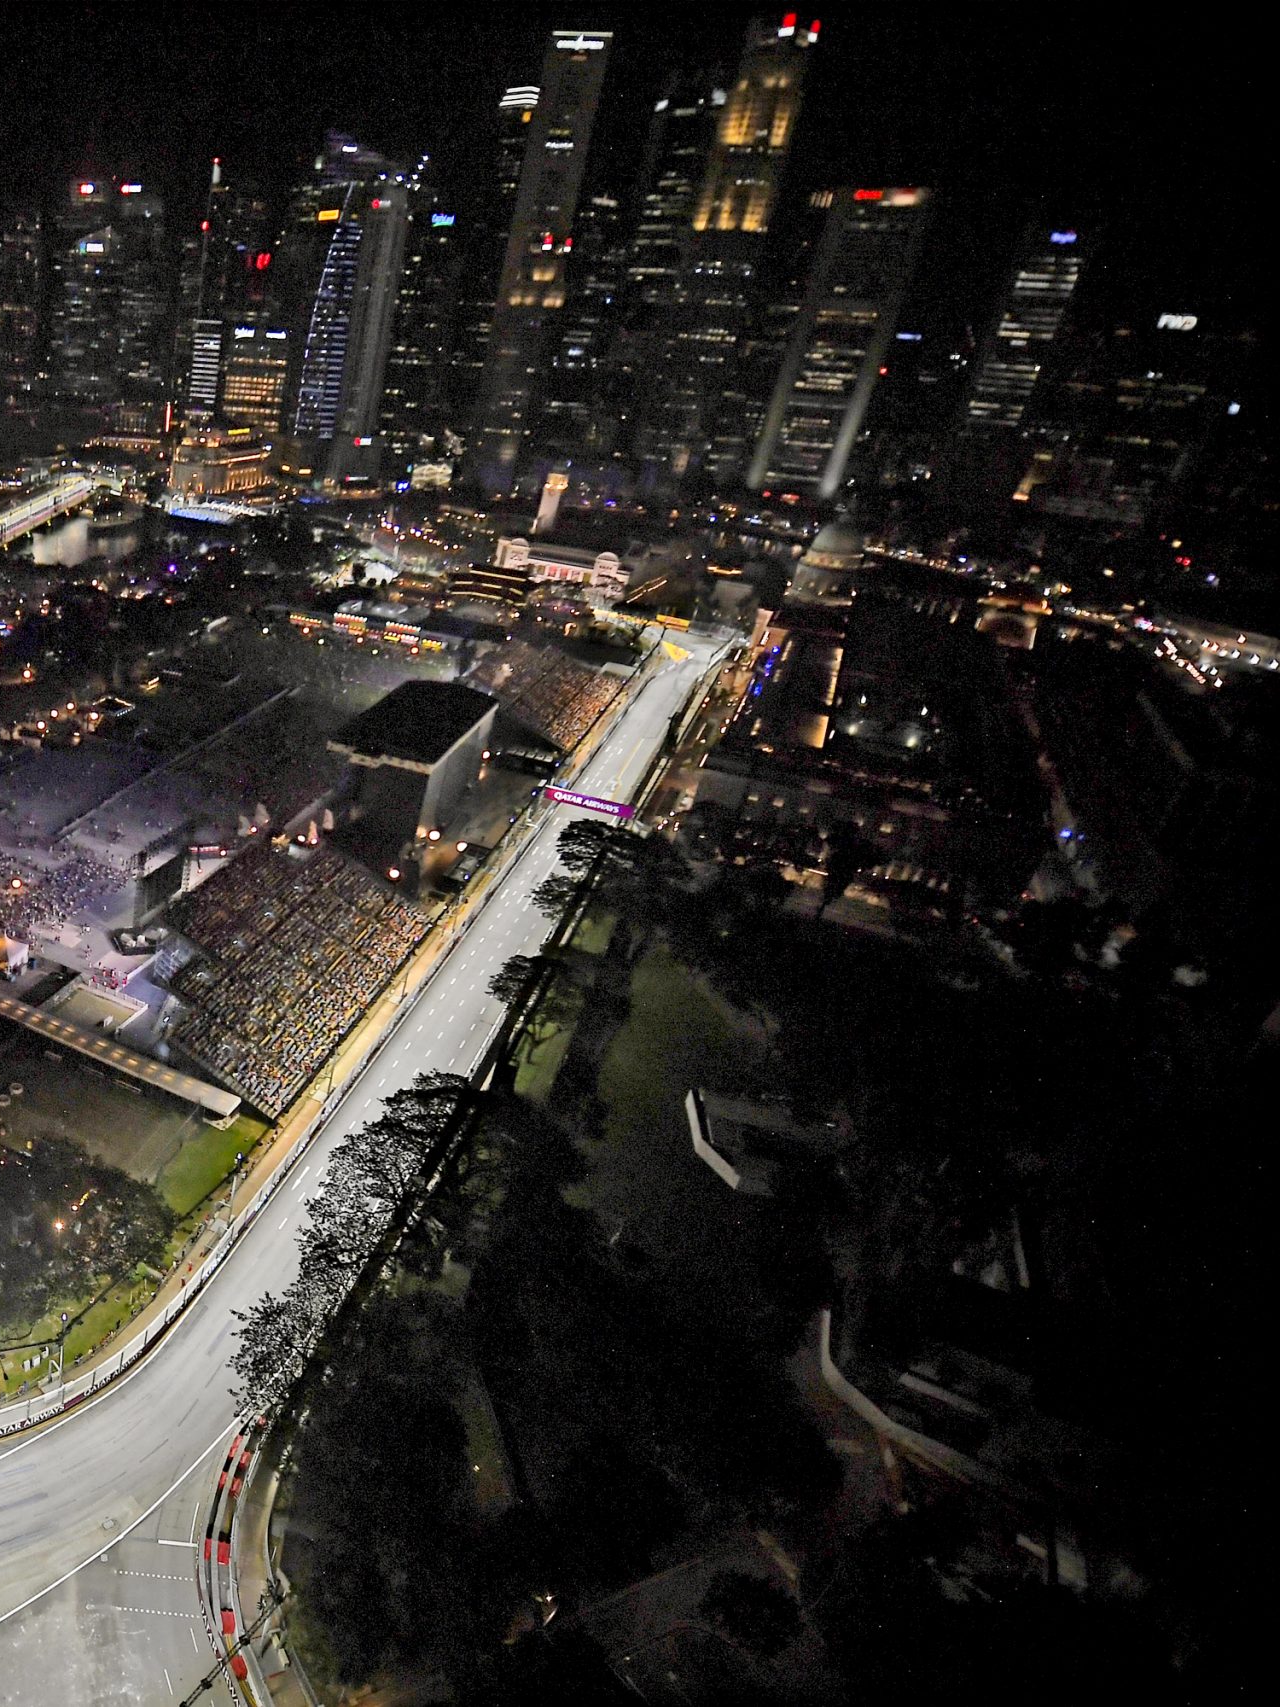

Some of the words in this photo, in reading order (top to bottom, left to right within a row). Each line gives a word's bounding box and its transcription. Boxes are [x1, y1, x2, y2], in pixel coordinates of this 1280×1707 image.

[554, 791, 583, 804] QATAR
[583, 799, 620, 813] AIRWAYS
[23, 1404, 64, 1427] AIRWAYS
